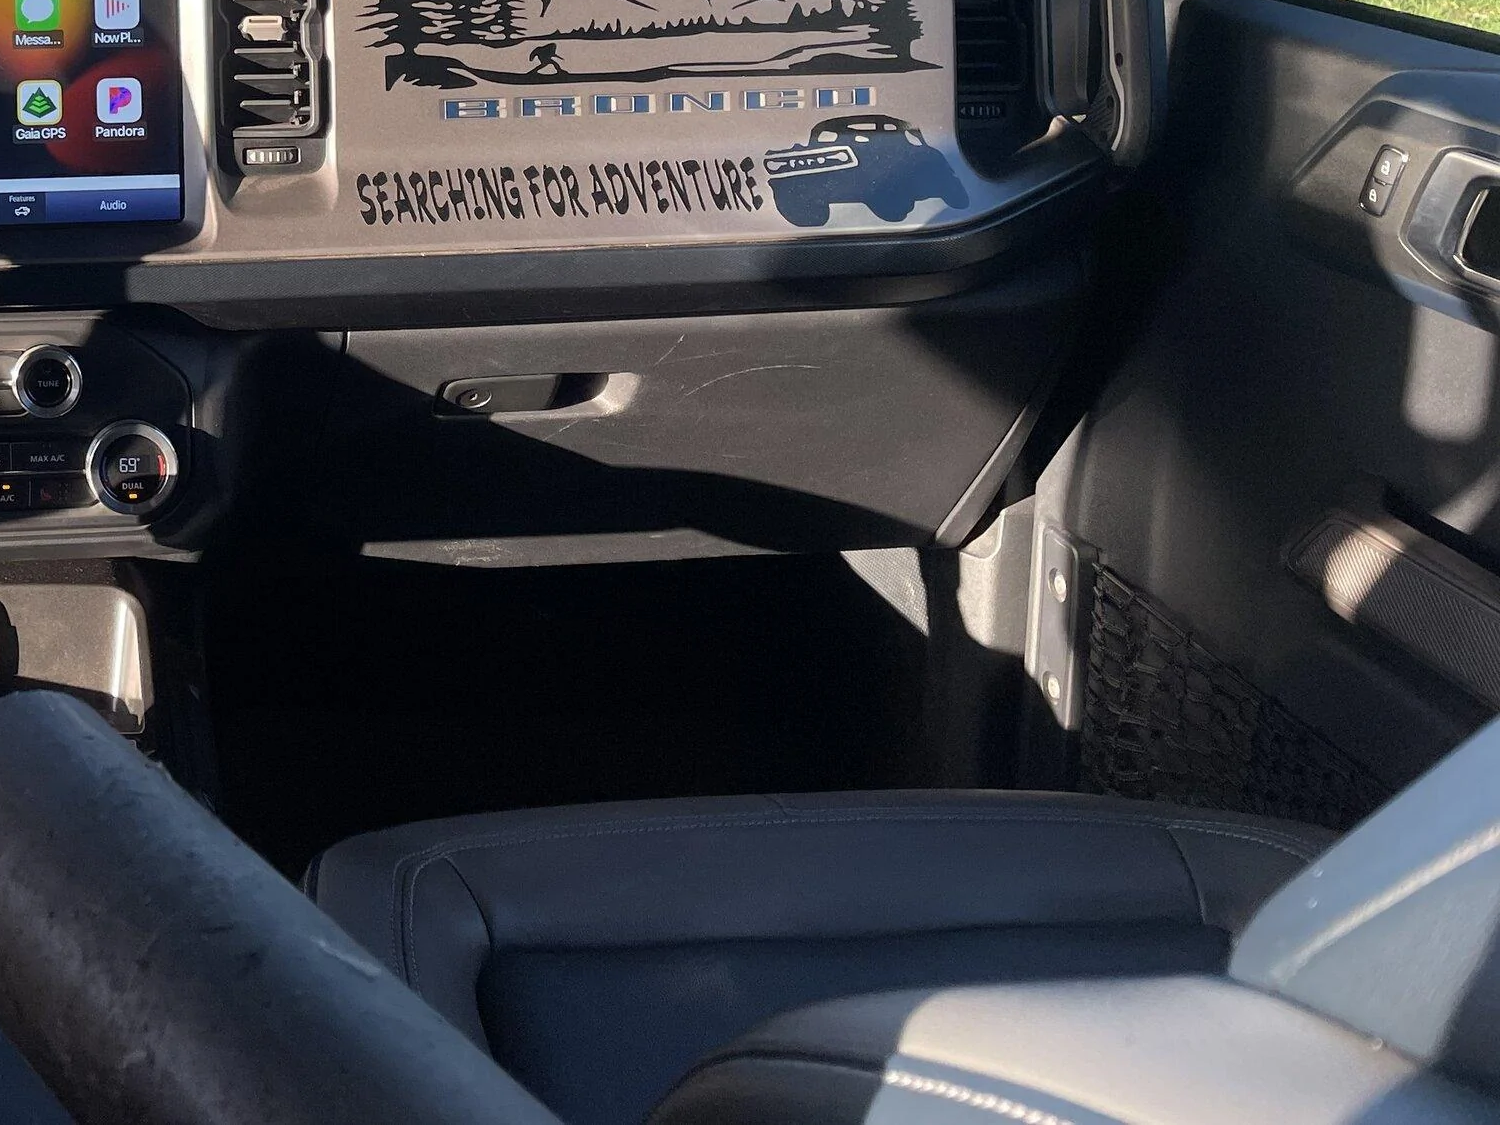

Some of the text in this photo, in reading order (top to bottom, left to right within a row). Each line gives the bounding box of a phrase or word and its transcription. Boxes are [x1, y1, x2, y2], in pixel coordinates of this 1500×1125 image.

[94, 32, 120, 44] Now
[440, 86, 877, 120] BRONCO
[15, 127, 66, 140] Gaia GPS
[95, 125, 145, 138] Pandora
[356, 156, 763, 225] SEARCHING FOR ADVENTURE
[8, 194, 36, 203] Features
[100, 200, 126, 210] Audio
[37, 380, 60, 388] TUNE
[30, 454, 65, 463] MAX A/C
[121, 482, 144, 490] DUAL
[0, 494, 15, 502] A/C
